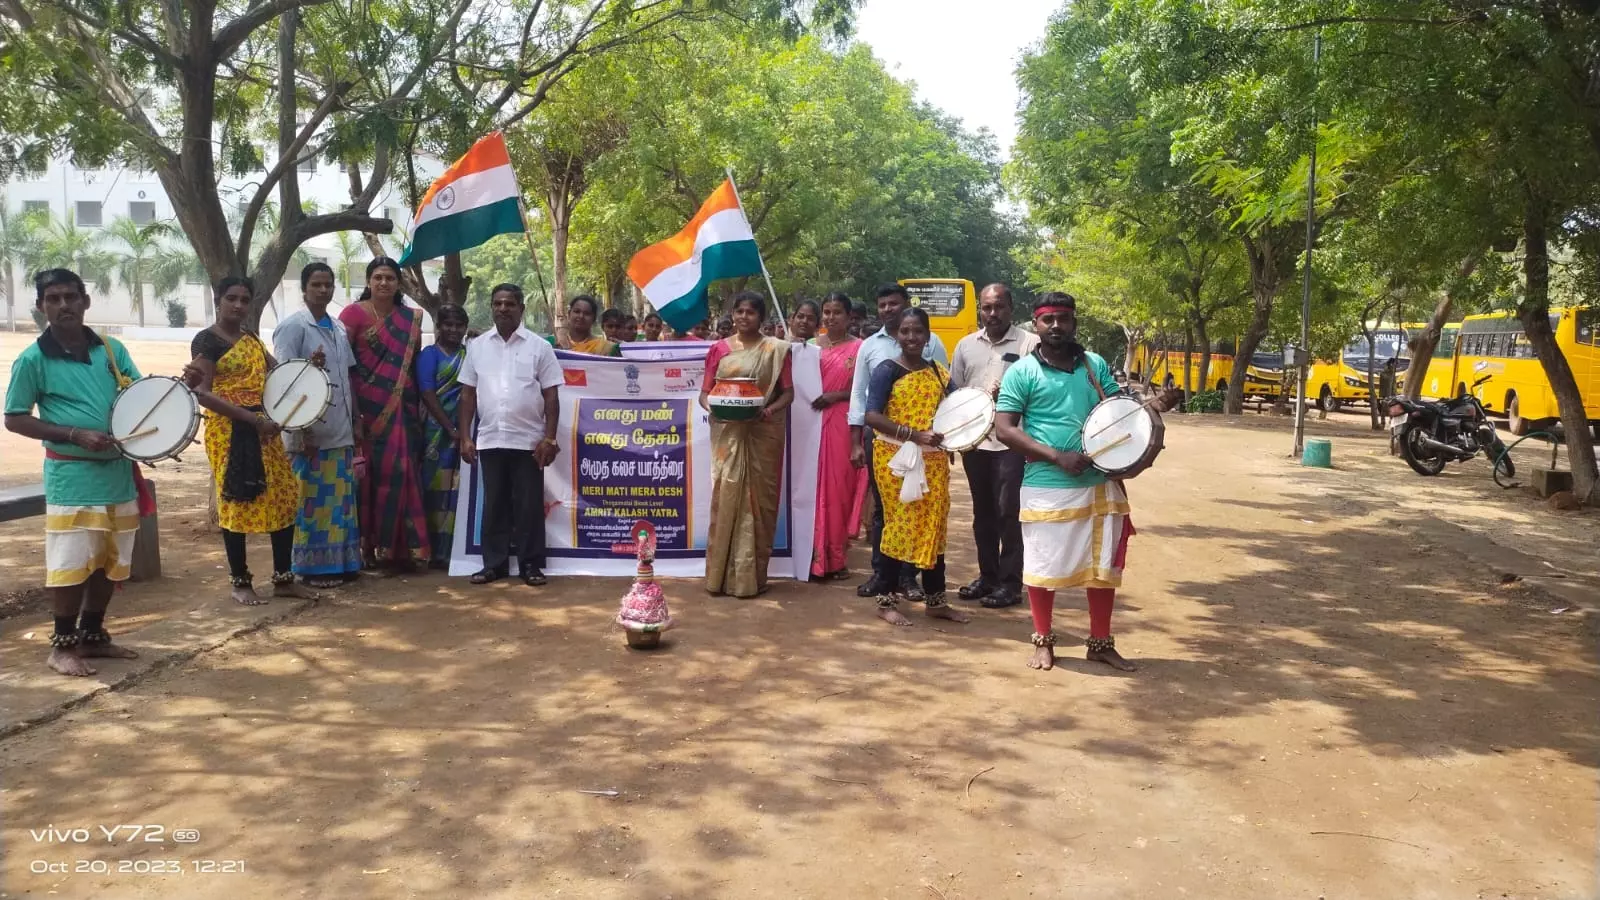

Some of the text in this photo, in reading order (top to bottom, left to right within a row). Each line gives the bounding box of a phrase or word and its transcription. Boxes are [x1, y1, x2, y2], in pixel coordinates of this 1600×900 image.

[594, 401, 674, 425] எனது மண்
[584, 426, 680, 450] எனது தேசம்
[580, 450, 684, 482] அமுத கலச யாத்திரை
[582, 486, 683, 497] MERI MATI MERA DESH
[650, 499, 664, 507] Level
[584, 507, 678, 518] AMRIT KALASH YATRA
